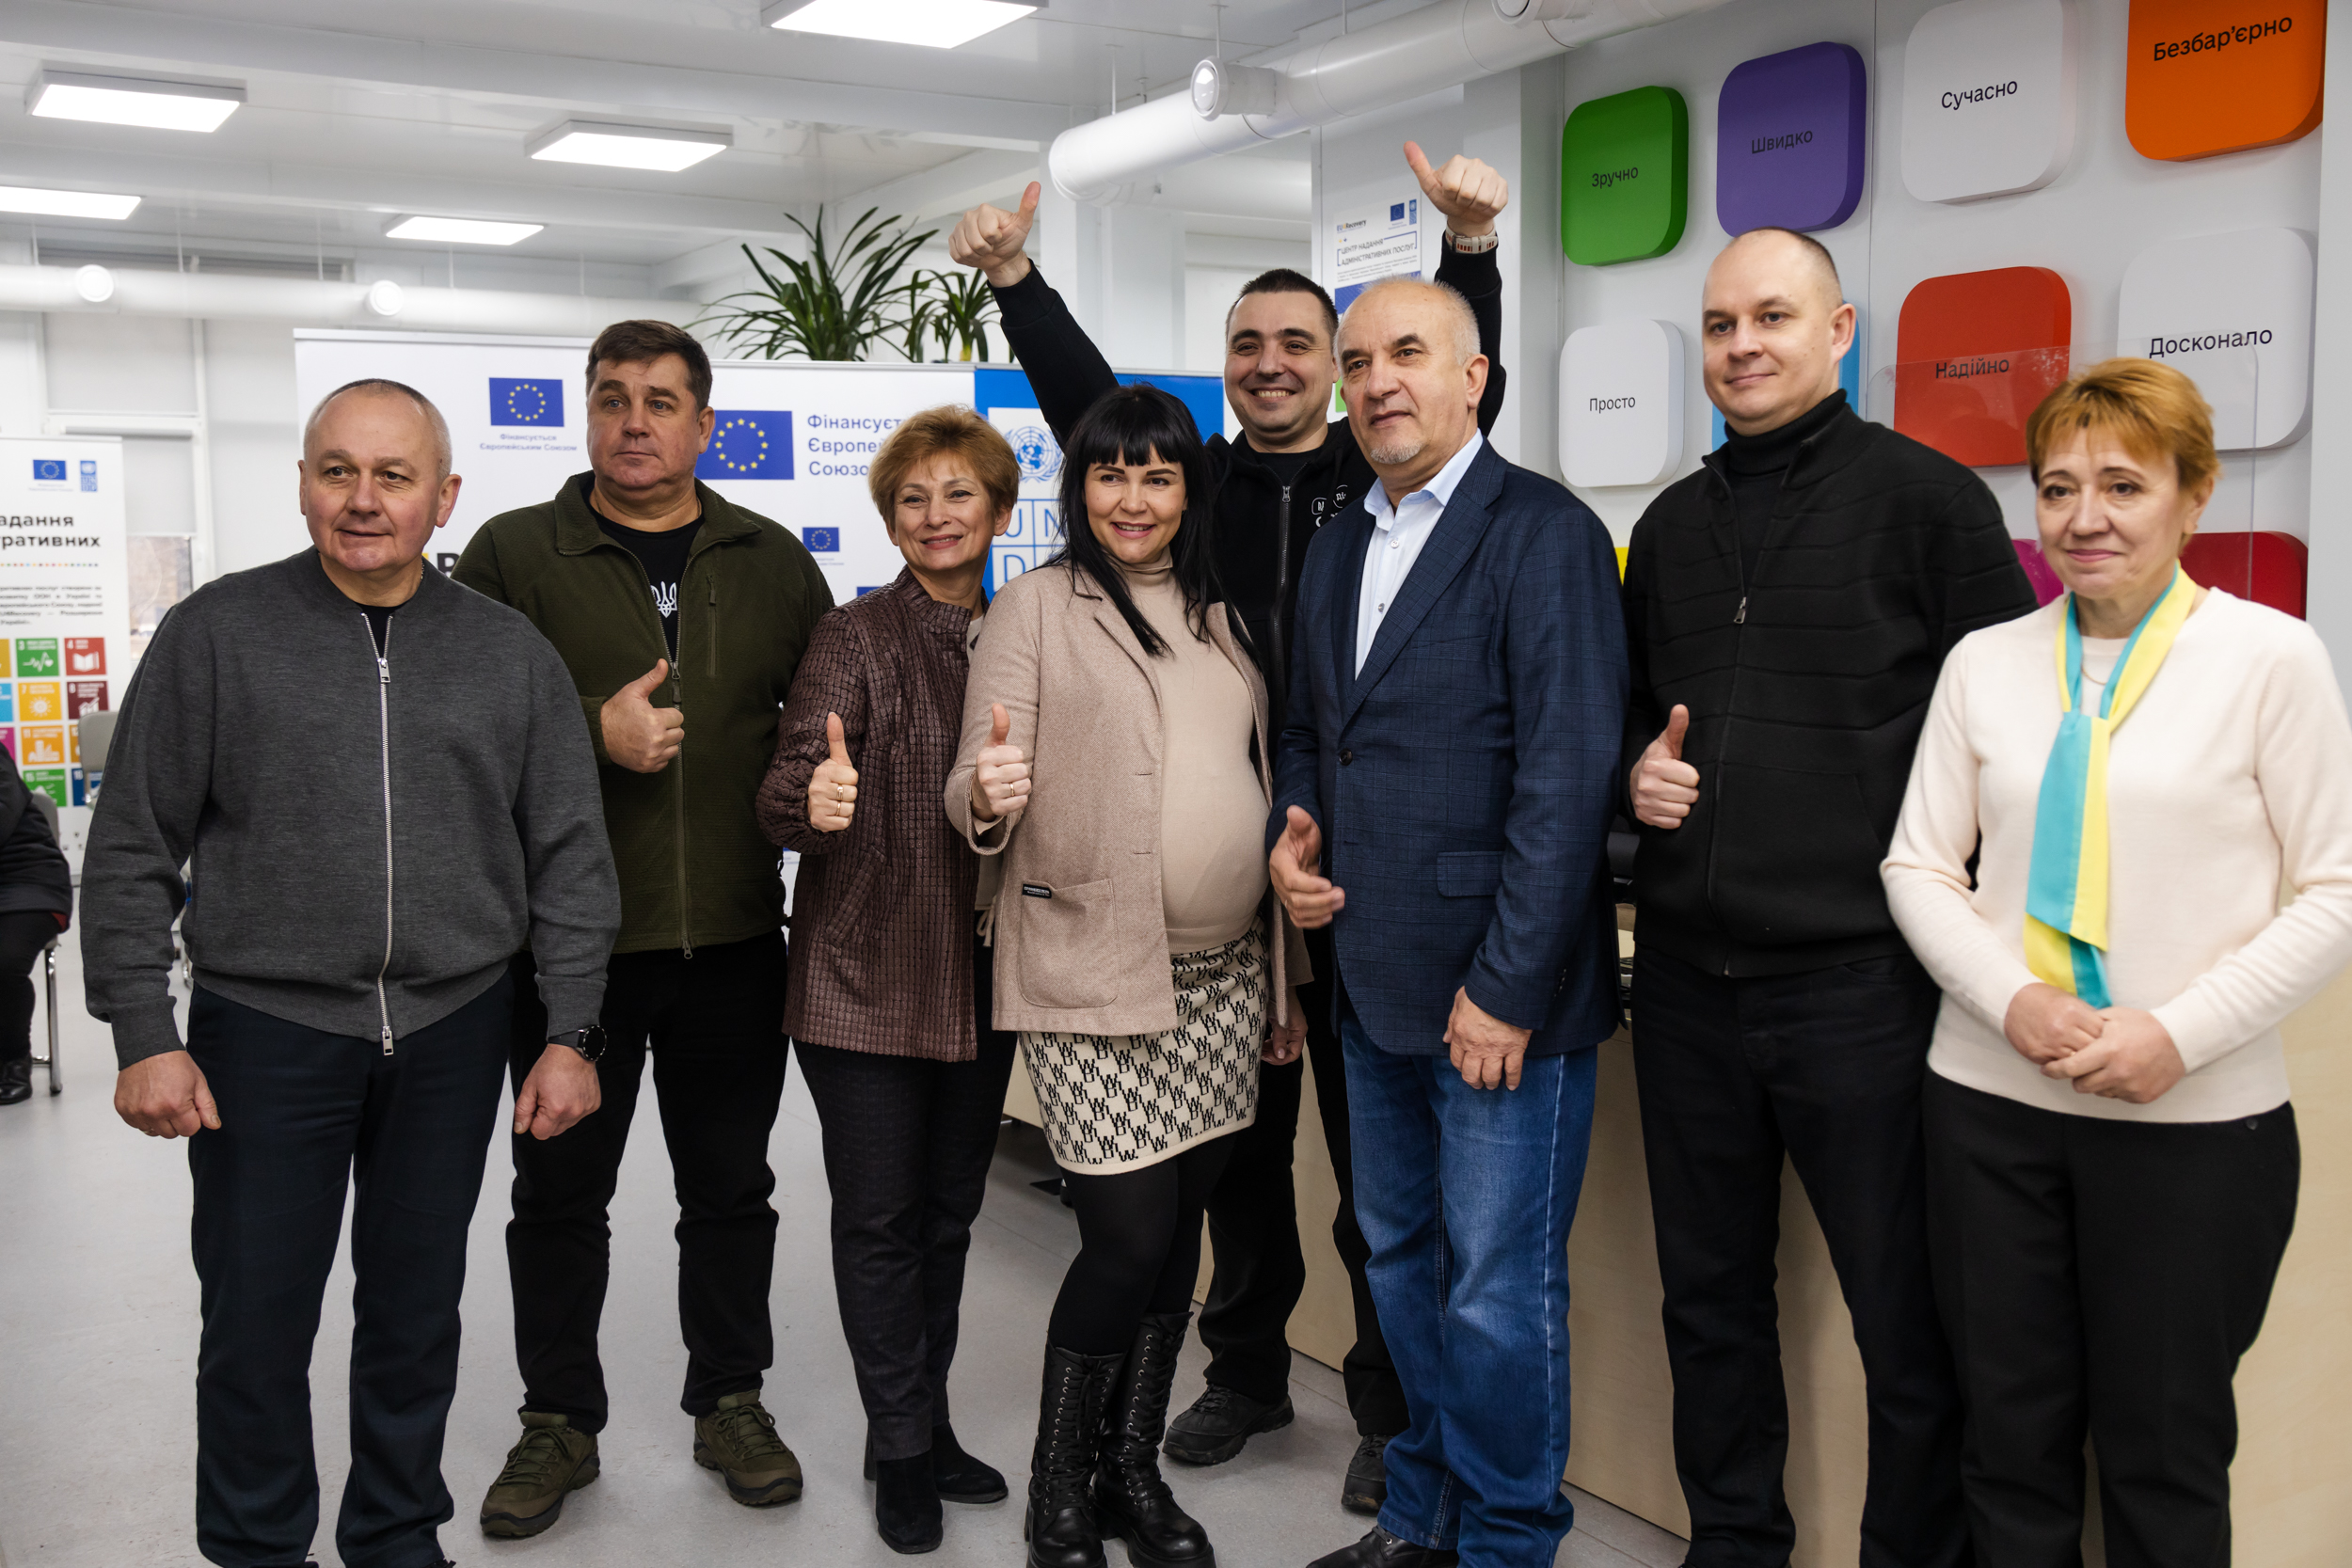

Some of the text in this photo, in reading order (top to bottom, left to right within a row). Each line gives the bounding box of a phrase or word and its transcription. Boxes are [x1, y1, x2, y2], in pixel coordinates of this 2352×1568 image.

[1941, 80, 2018, 111] Сучасно
[1751, 130, 1813, 154] Швидко
[1591, 166, 1639, 189] Зручно
[2149, 329, 2273, 359] Досконало
[1935, 357, 2010, 379] Надійно
[1589, 396, 1636, 414] Просто
[0, 535, 101, 550] ративних
